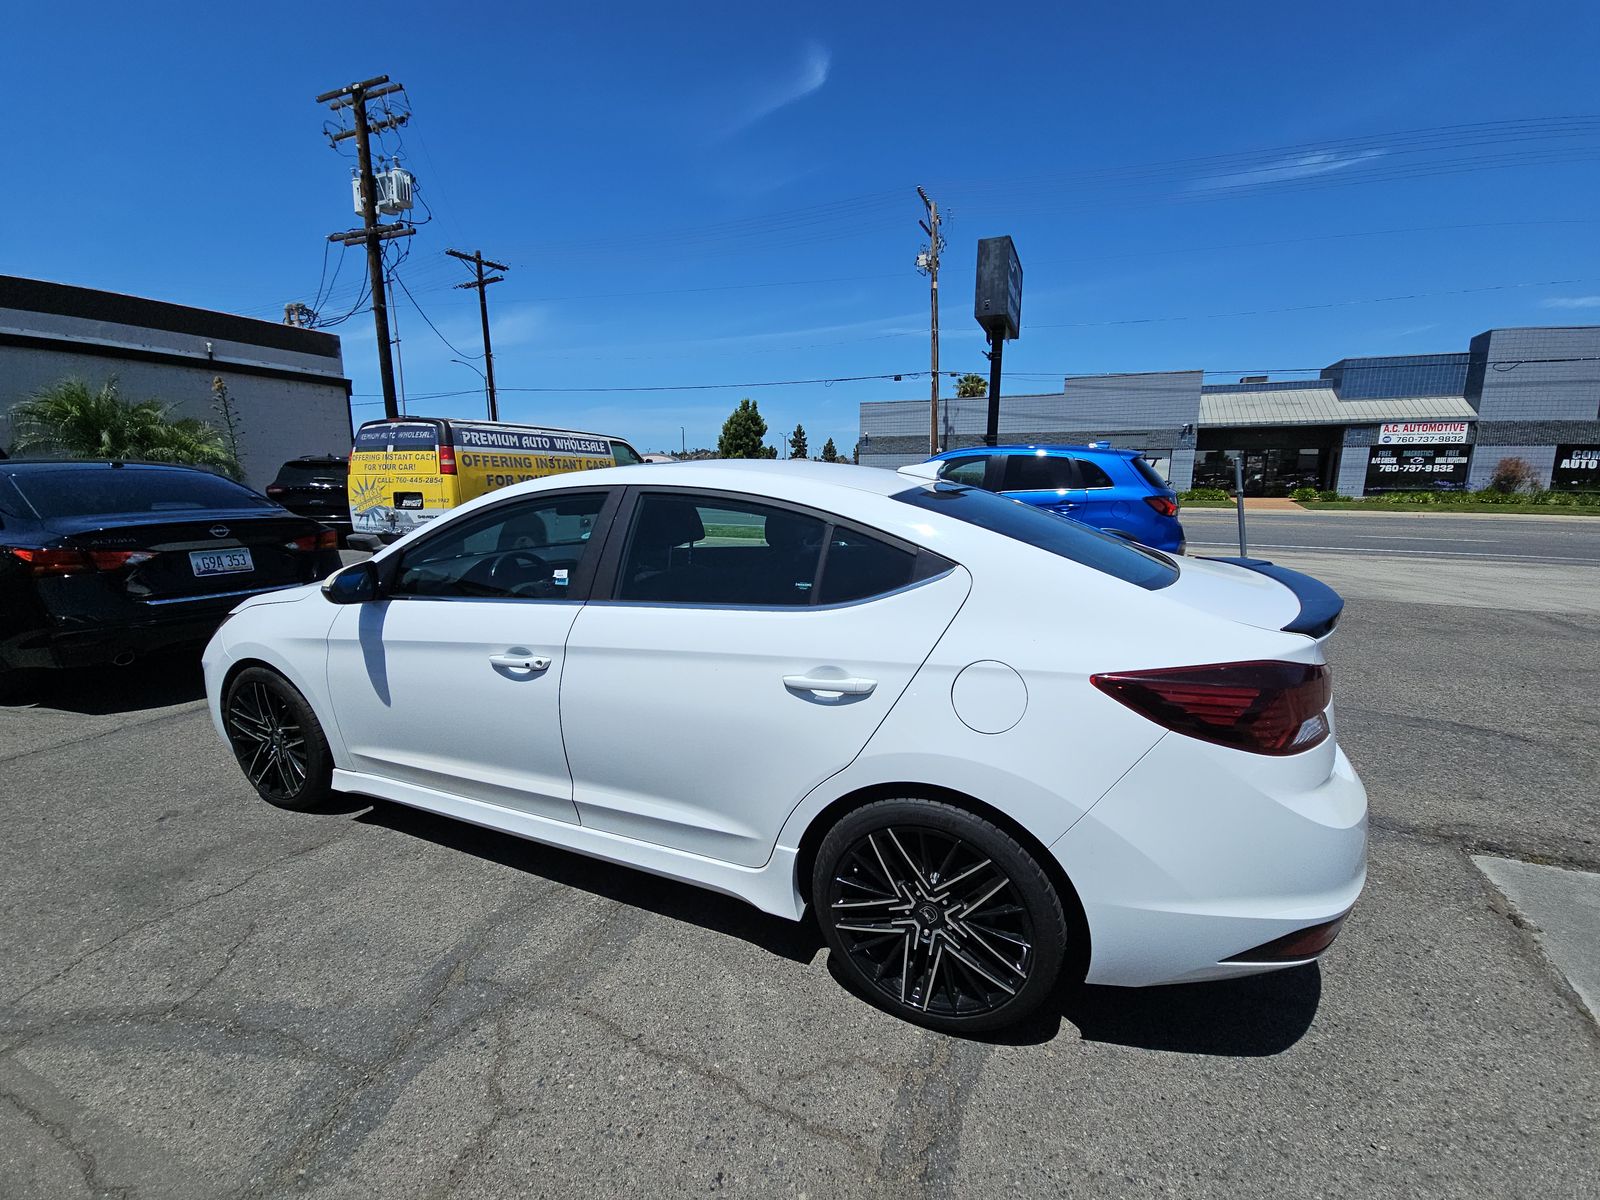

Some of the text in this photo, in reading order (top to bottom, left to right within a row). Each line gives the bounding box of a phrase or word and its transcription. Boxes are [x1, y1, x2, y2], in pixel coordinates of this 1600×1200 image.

[1383, 423, 1466, 432] A.C. AUTOMOTIVE
[461, 431, 606, 452] PREMIUM AUTO WHOLESALE
[1396, 435, 1464, 443] 760-737-9832
[352, 453, 381, 461] OFFERING
[382, 453, 412, 461] INSTANT
[461, 453, 611, 470] OFFERING INSTANT CASH
[1560, 458, 1598, 469] AUTO
[485, 474, 513, 487] FOR
[90, 537, 137, 545] ALTIMA
[201, 553, 247, 570] G9A 353
